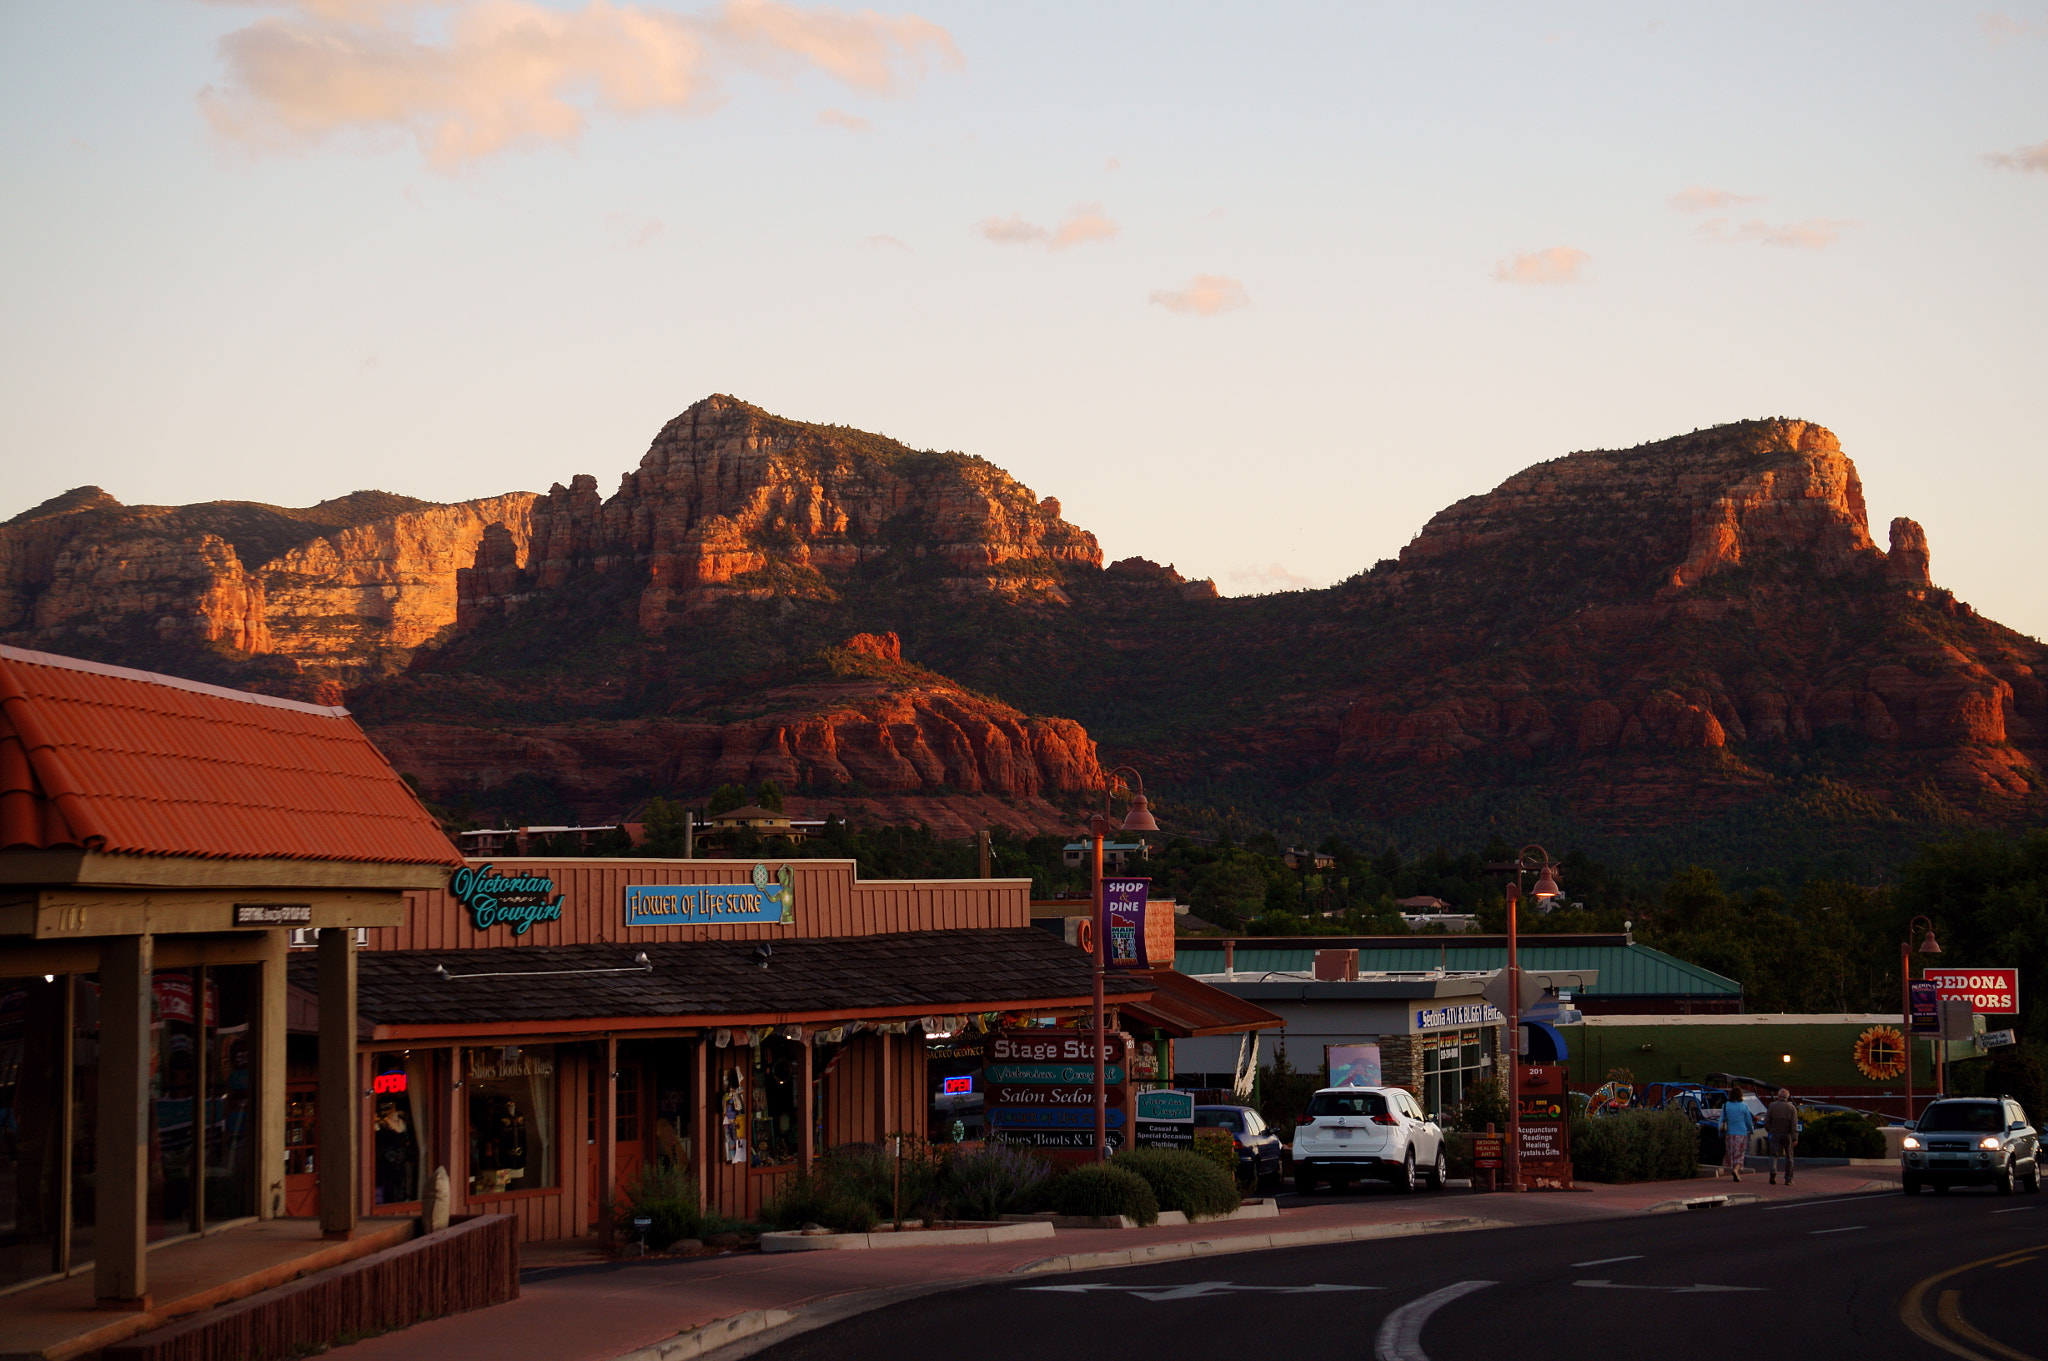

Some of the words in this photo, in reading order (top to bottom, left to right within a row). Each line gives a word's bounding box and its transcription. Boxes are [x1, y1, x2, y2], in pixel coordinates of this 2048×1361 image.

[453, 865, 555, 902] Victorian
[1109, 882, 1144, 893] SHOP
[471, 893, 566, 934] Cowgirl
[682, 894, 696, 921] OF
[726, 893, 762, 914] STORE
[1110, 901, 1139, 912] DINE
[1933, 976, 2008, 989] SEDONA
[1422, 1011, 1445, 1028] Sedona
[1445, 1008, 1458, 1025] ATV
[1458, 1007, 1464, 1024] &
[1464, 1004, 1483, 1023] BUGGY
[994, 1040, 1058, 1060] Stage
[992, 1067, 1057, 1083] Victorian
[1061, 1067, 1116, 1085] Cowgrl
[374, 1074, 407, 1094] OPEN
[946, 1079, 970, 1092] OPEN
[1000, 1087, 1045, 1104] Salon
[1140, 1096, 1185, 1107] Victorian
[1152, 1105, 1190, 1117] Cowgirl
[1081, 1113, 1116, 1124] STRE
[997, 1132, 1032, 1146] Shoes
[1033, 1133, 1071, 1146] Boots
[1073, 1133, 1084, 1146] &
[1085, 1133, 1117, 1147] Bgs
[1137, 1132, 1161, 1140] Special
[1523, 1134, 1552, 1142] Readings
